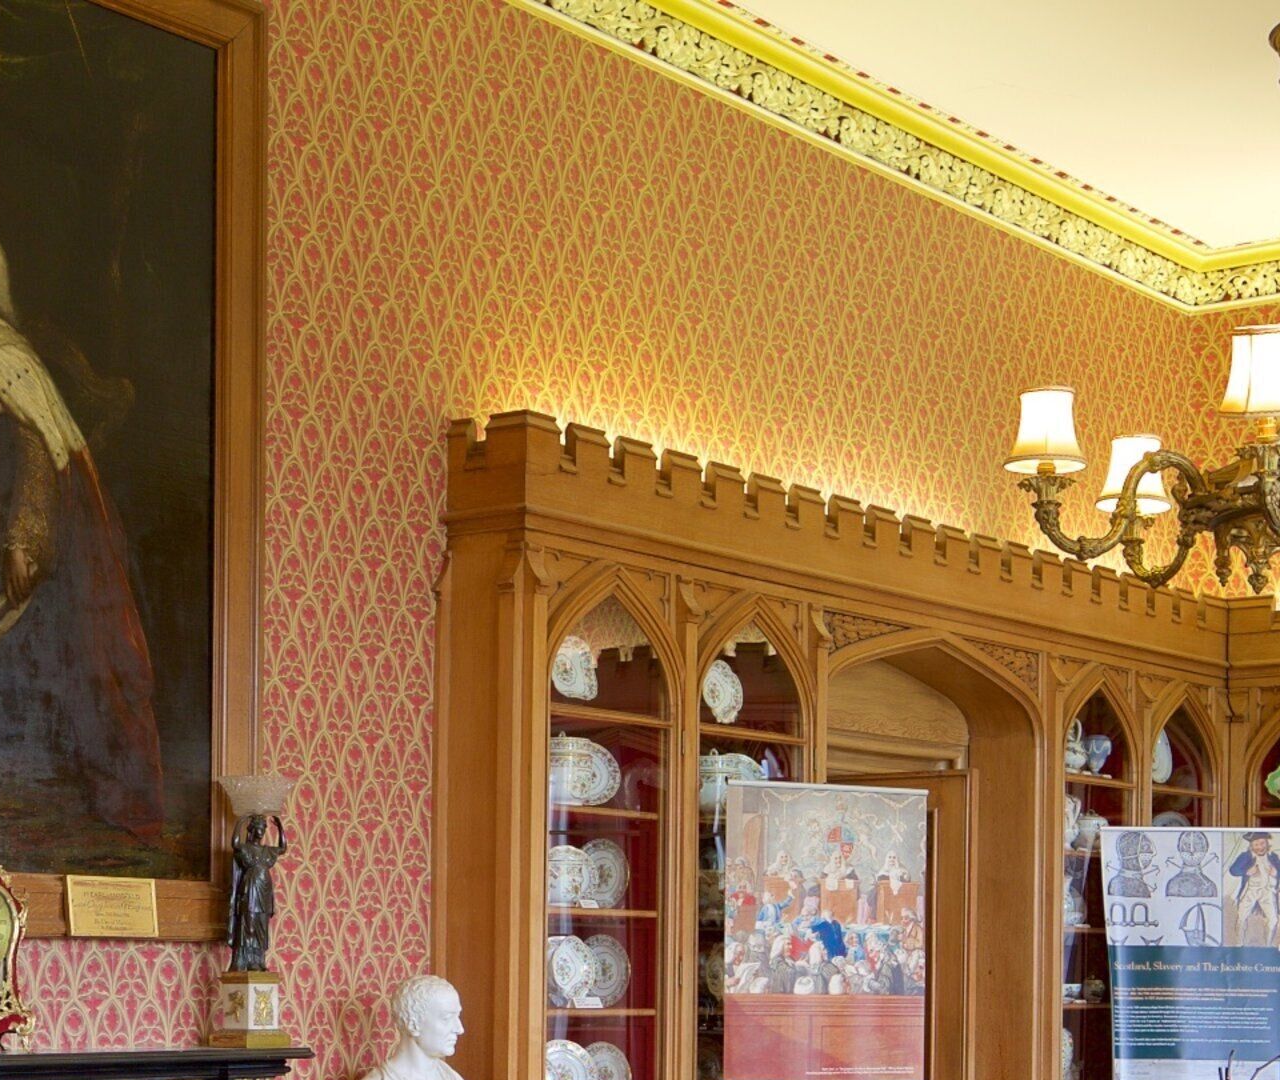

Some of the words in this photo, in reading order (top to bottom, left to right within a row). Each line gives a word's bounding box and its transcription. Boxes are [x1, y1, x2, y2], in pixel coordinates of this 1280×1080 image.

[1114, 961, 1151, 972] Scotland,
[1153, 961, 1182, 973] Slavery
[1186, 962, 1200, 972] and
[1202, 962, 1219, 973] The
[1221, 962, 1252, 974] Jacobite
